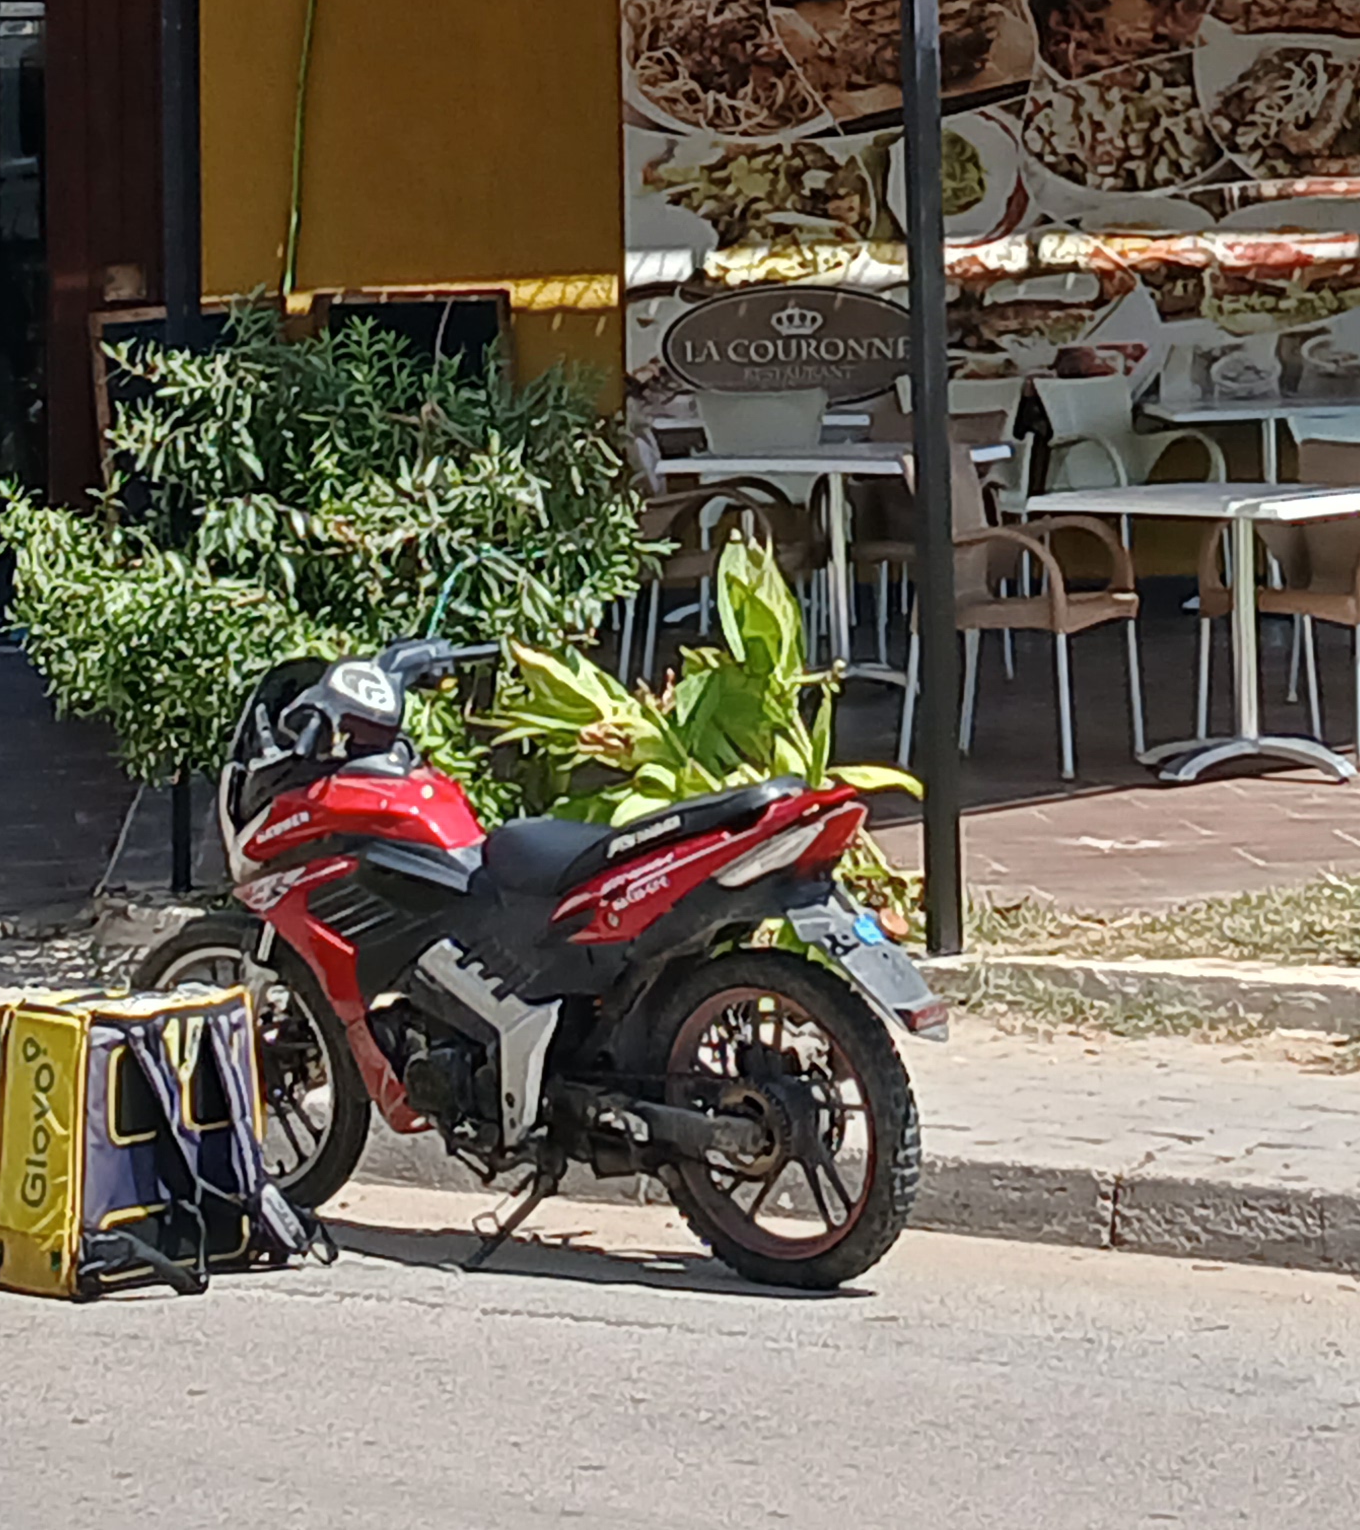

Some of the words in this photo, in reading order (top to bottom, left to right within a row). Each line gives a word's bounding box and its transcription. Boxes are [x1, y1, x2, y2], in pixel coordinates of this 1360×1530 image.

[685, 338, 720, 363] LA
[727, 336, 911, 363] COURONNE
[21, 1061, 57, 1209] Glovo
